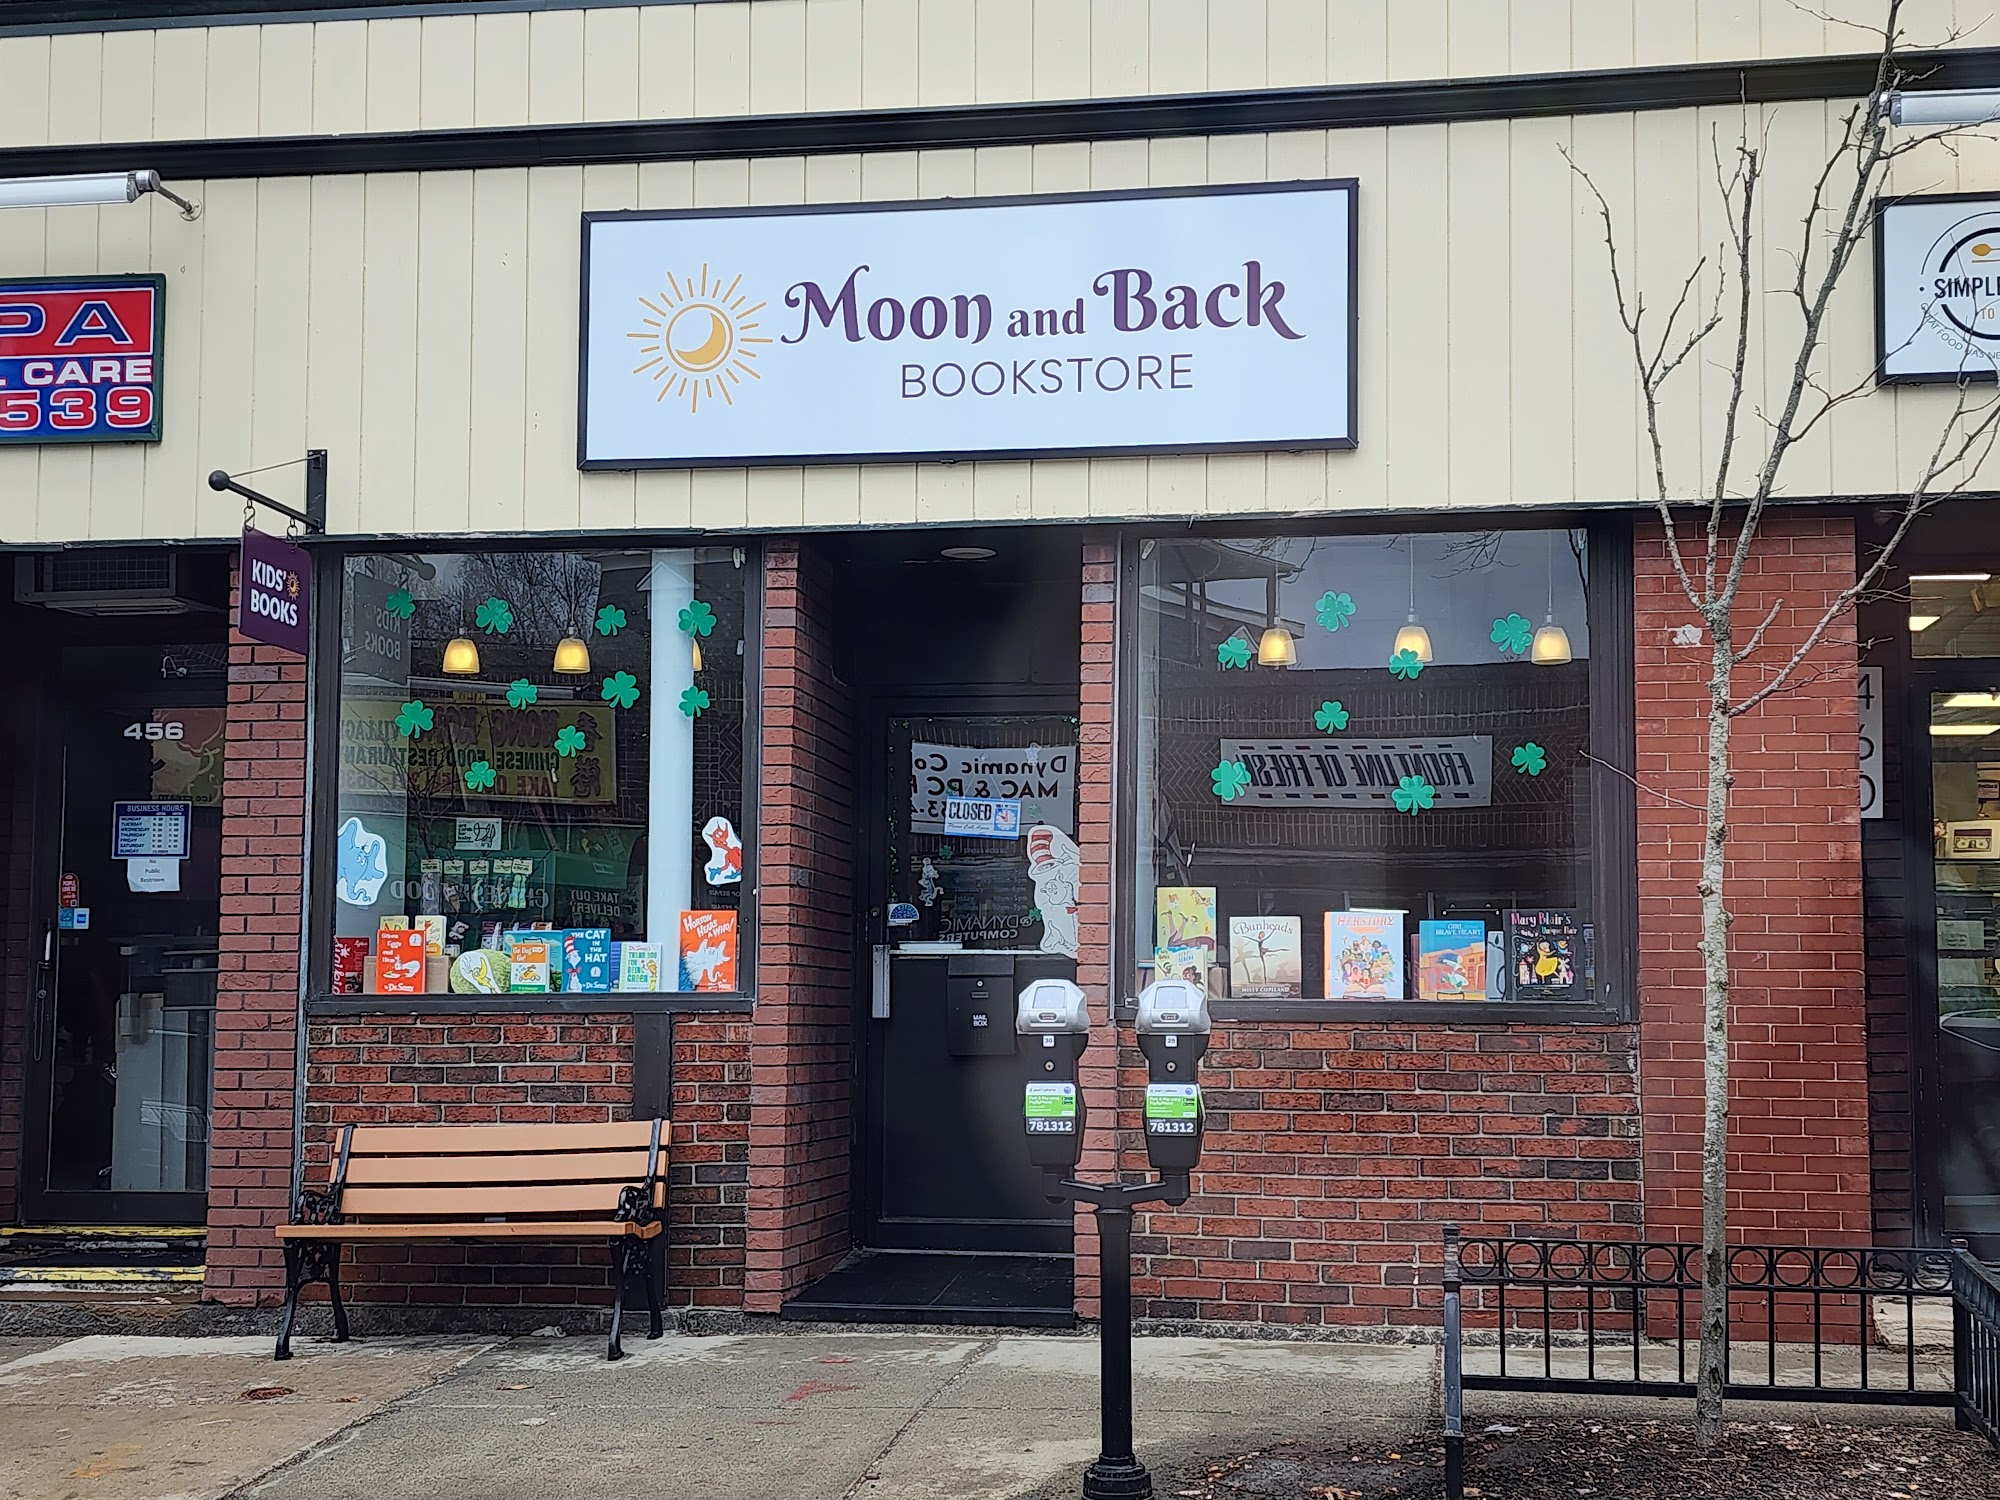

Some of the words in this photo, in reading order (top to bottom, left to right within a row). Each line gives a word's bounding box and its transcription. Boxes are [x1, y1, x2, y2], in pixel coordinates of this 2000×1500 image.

[781, 264, 993, 344] Moon
[1007, 298, 1087, 337] and
[1093, 260, 1307, 340] Back
[1936, 329, 1963, 350] FOOD
[24, 359, 152, 385] CARE
[902, 354, 1193, 399] BOOKSTORE
[0, 387, 153, 431] 539
[252, 559, 287, 591] KIDS'
[250, 588, 298, 627] BOOKS
[124, 722, 184, 740] 456
[949, 802, 992, 821] CLOSED
[682, 913, 713, 933] HORTON
[696, 919, 718, 938] HEARS
[707, 931, 714, 939] A
[713, 917, 735, 938] WHO!
[1232, 919, 1294, 935] Bunheads
[1511, 912, 1537, 928] Mary
[1538, 911, 1572, 925] Blair's
[570, 931, 584, 939] THE
[584, 930, 607, 940] CAT
[584, 953, 608, 963] HAT
[628, 951, 646, 959] THANK
[626, 974, 649, 983] GREEN
[1028, 1121, 1073, 1132] 781312
[1149, 1122, 1194, 1133] 781312
